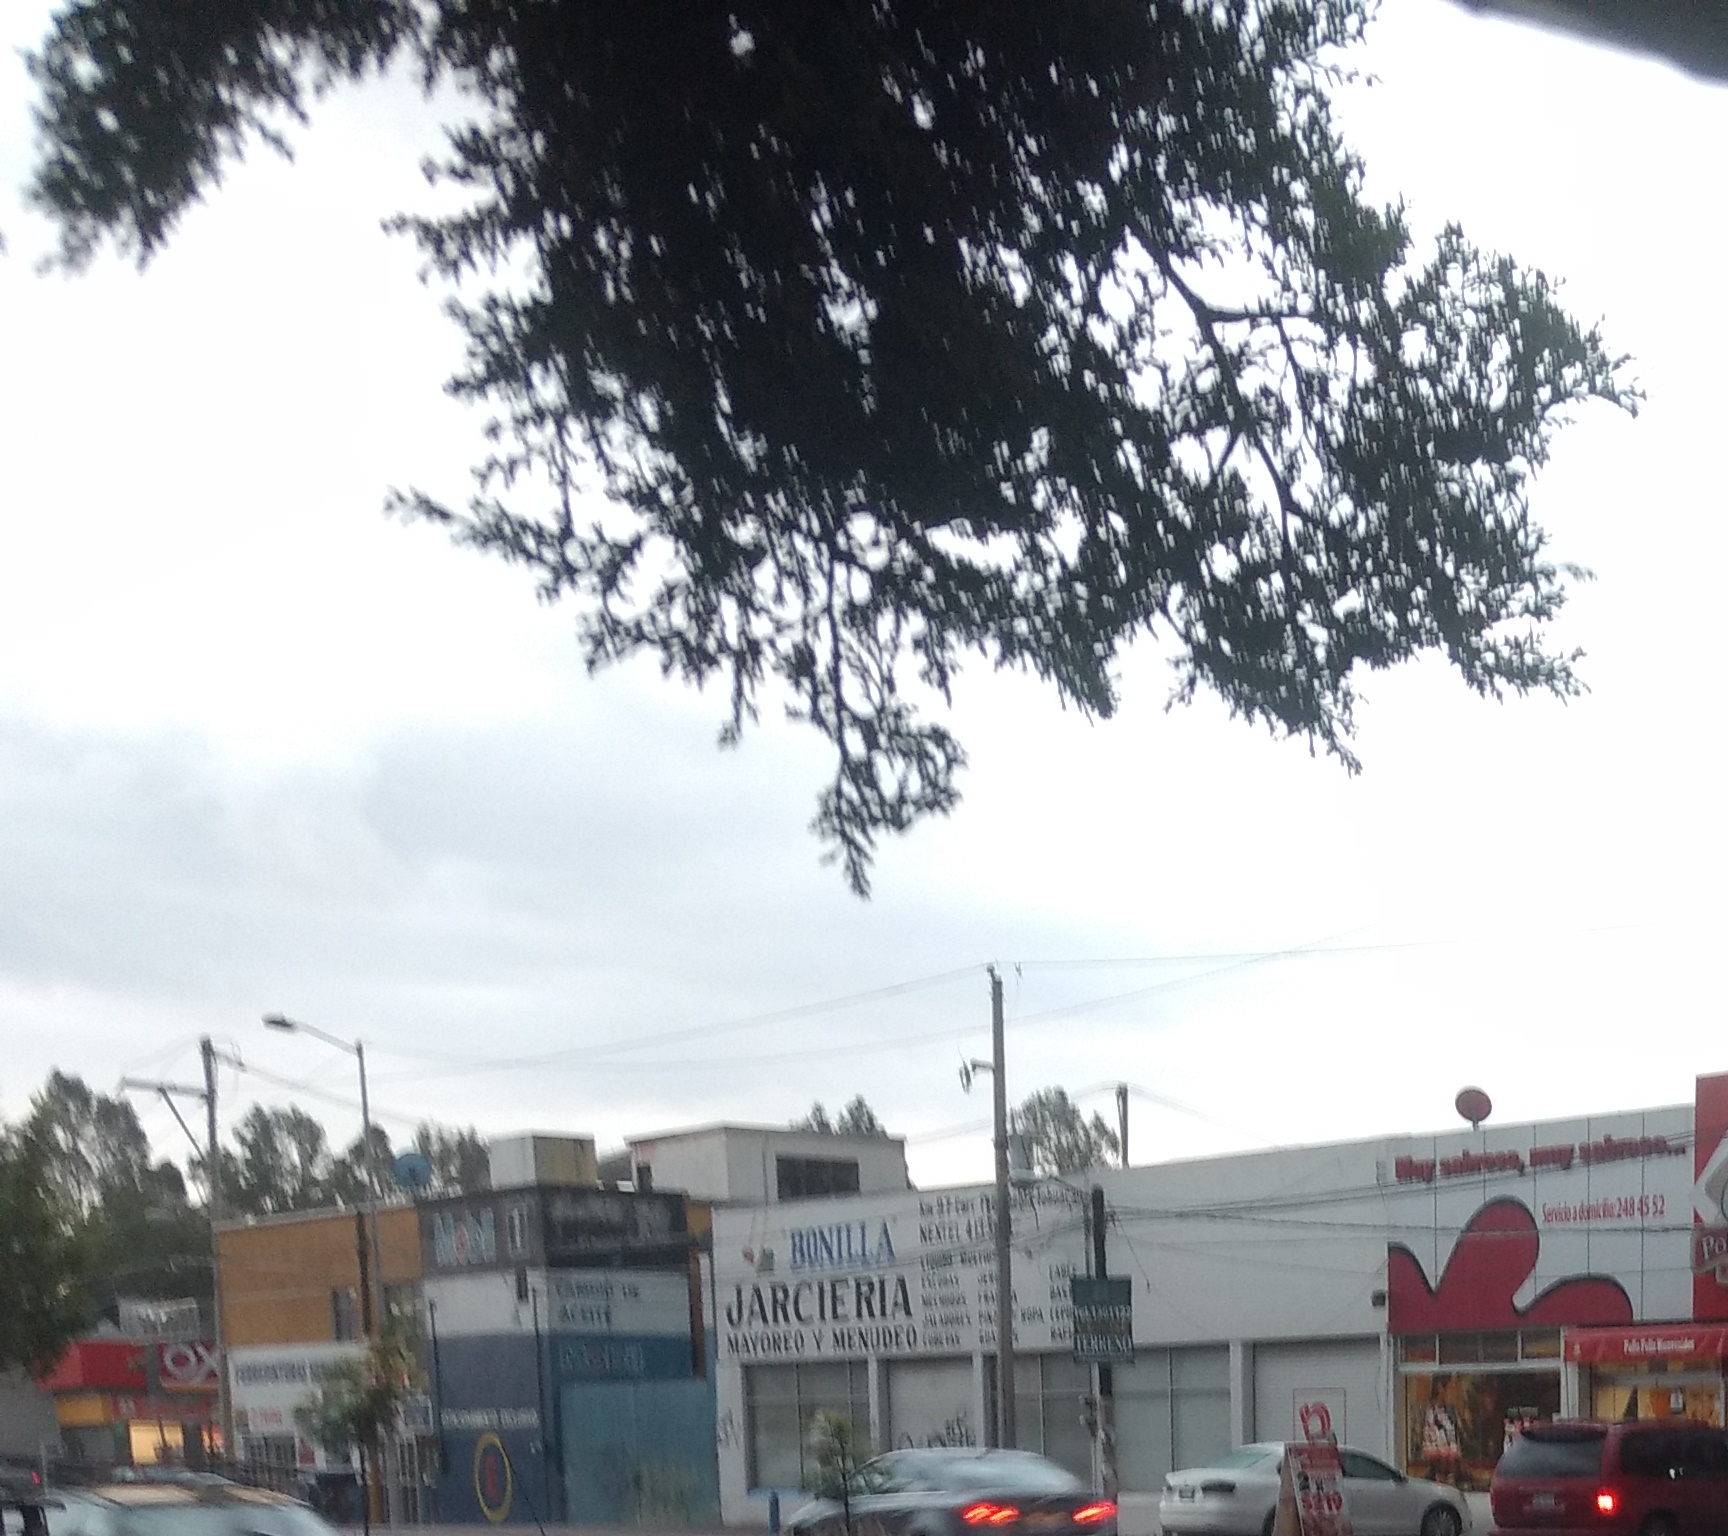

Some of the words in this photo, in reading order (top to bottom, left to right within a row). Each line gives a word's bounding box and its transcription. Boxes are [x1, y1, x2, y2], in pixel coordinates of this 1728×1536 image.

[1395, 1154, 1435, 1184] Muy
[1542, 1202, 1571, 1223] Servicio
[1652, 1195, 1665, 1217] 52
[725, 1273, 913, 1327] JARCIERIA
[726, 1329, 805, 1356] MAYOREO
[812, 1328, 824, 1351] Y
[832, 1322, 918, 1352] MENUDEO
